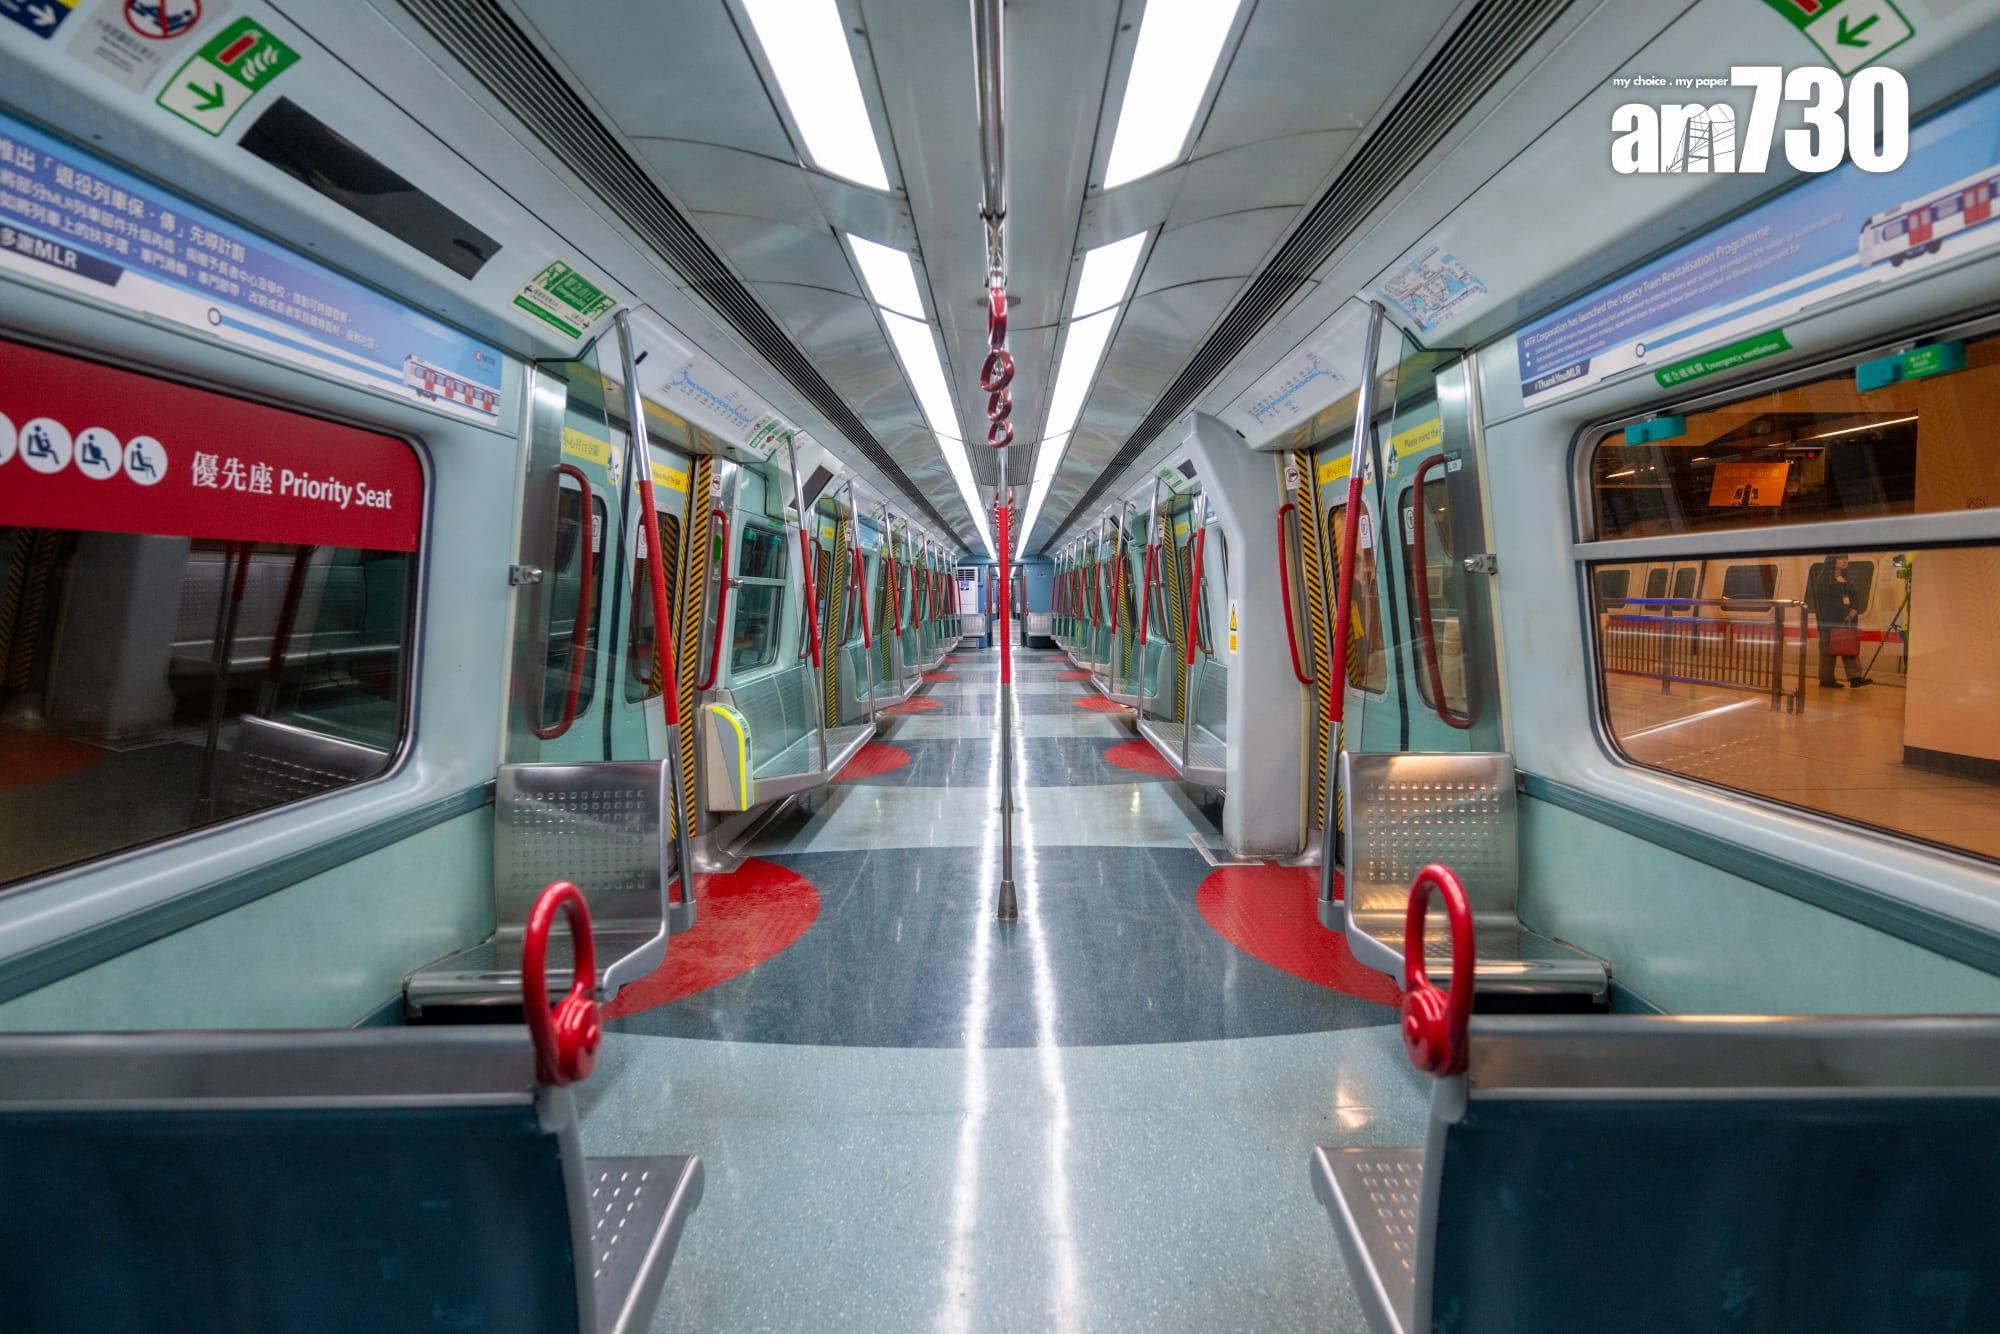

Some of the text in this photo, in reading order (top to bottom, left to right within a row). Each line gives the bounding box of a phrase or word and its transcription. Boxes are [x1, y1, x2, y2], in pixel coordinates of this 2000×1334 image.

[1524, 224, 1770, 348] MTR Corporation has launched the Legacy Train Revitalisation Programme
[1705, 354, 1744, 370] Emergency
[1534, 364, 1581, 390] #ThankYouMLR
[1404, 437, 1418, 449] Please
[1418, 432, 1430, 445] mind
[190, 451, 393, 511] 優先座 Priority Seat
